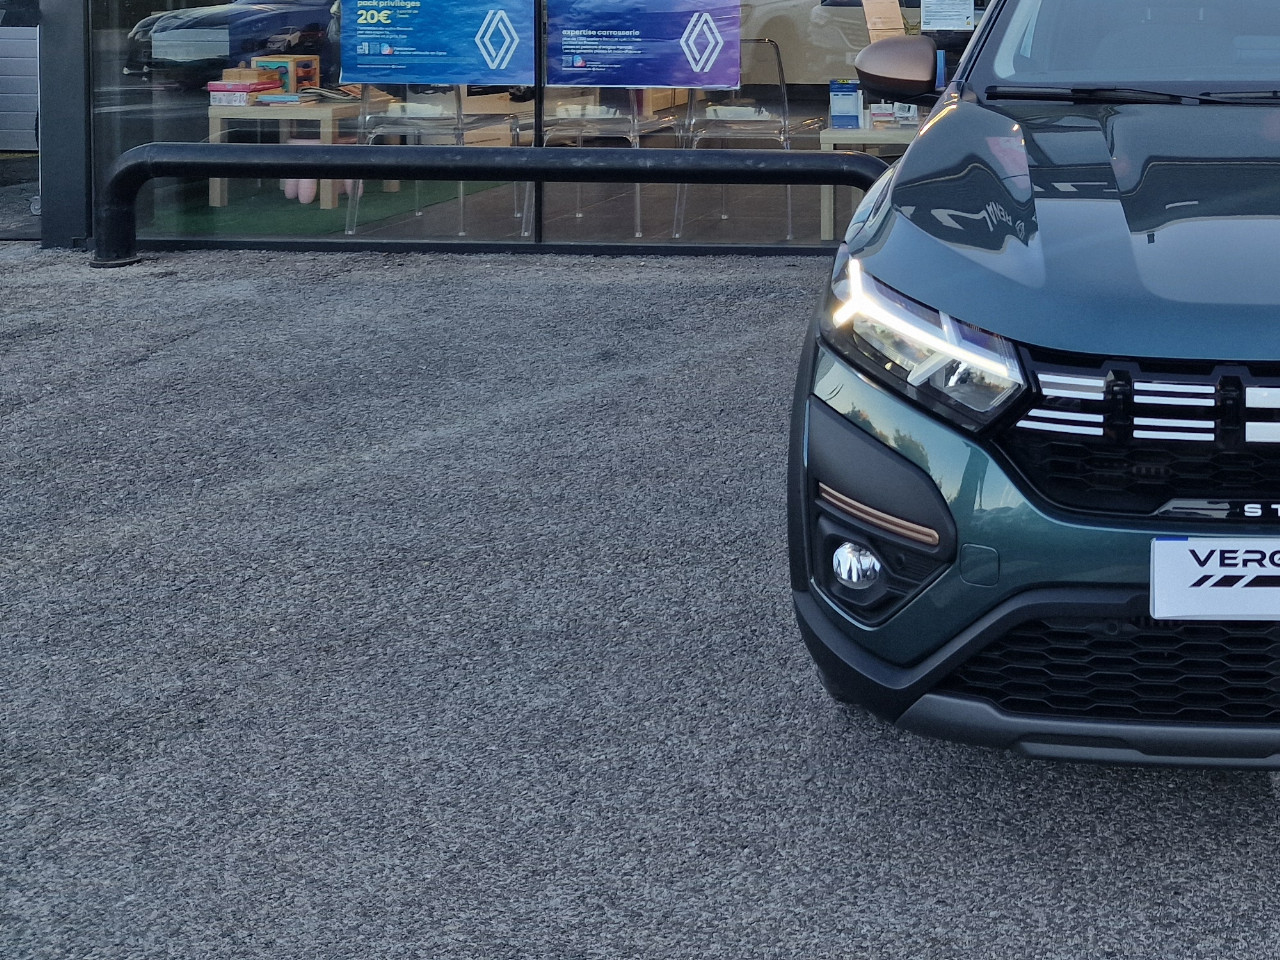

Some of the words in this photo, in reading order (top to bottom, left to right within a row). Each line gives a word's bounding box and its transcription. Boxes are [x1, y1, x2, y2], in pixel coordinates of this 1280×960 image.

[357, 0, 378, 8] pack
[379, 0, 421, 8] privilèges
[562, 29, 597, 37] expertise
